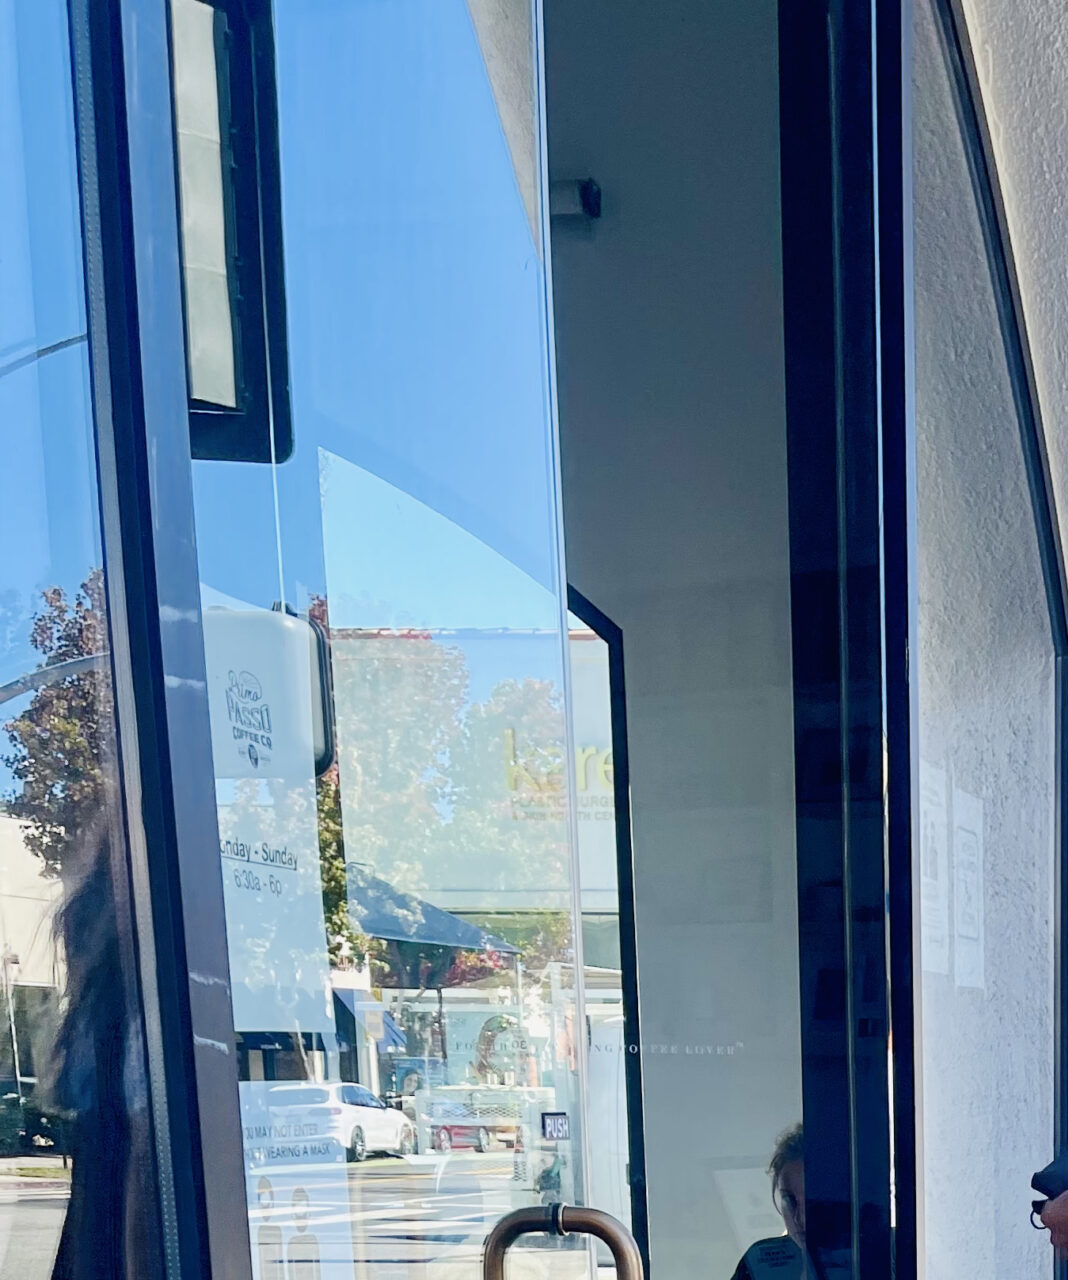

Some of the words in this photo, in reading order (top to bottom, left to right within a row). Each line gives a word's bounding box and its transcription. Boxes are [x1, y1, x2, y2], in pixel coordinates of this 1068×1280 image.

[225, 688, 271, 733] PASSO
[233, 726, 260, 744] COFFEE
[220, 837, 251, 862] onday
[262, 842, 297, 870] Sunday
[269, 874, 282, 898] 6p
[255, 1126, 272, 1138] MAY
[274, 1124, 291, 1138] NOT
[293, 1122, 318, 1137] ENTER
[545, 1118, 569, 1138] PUSH
[310, 1142, 330, 1155] MASK
